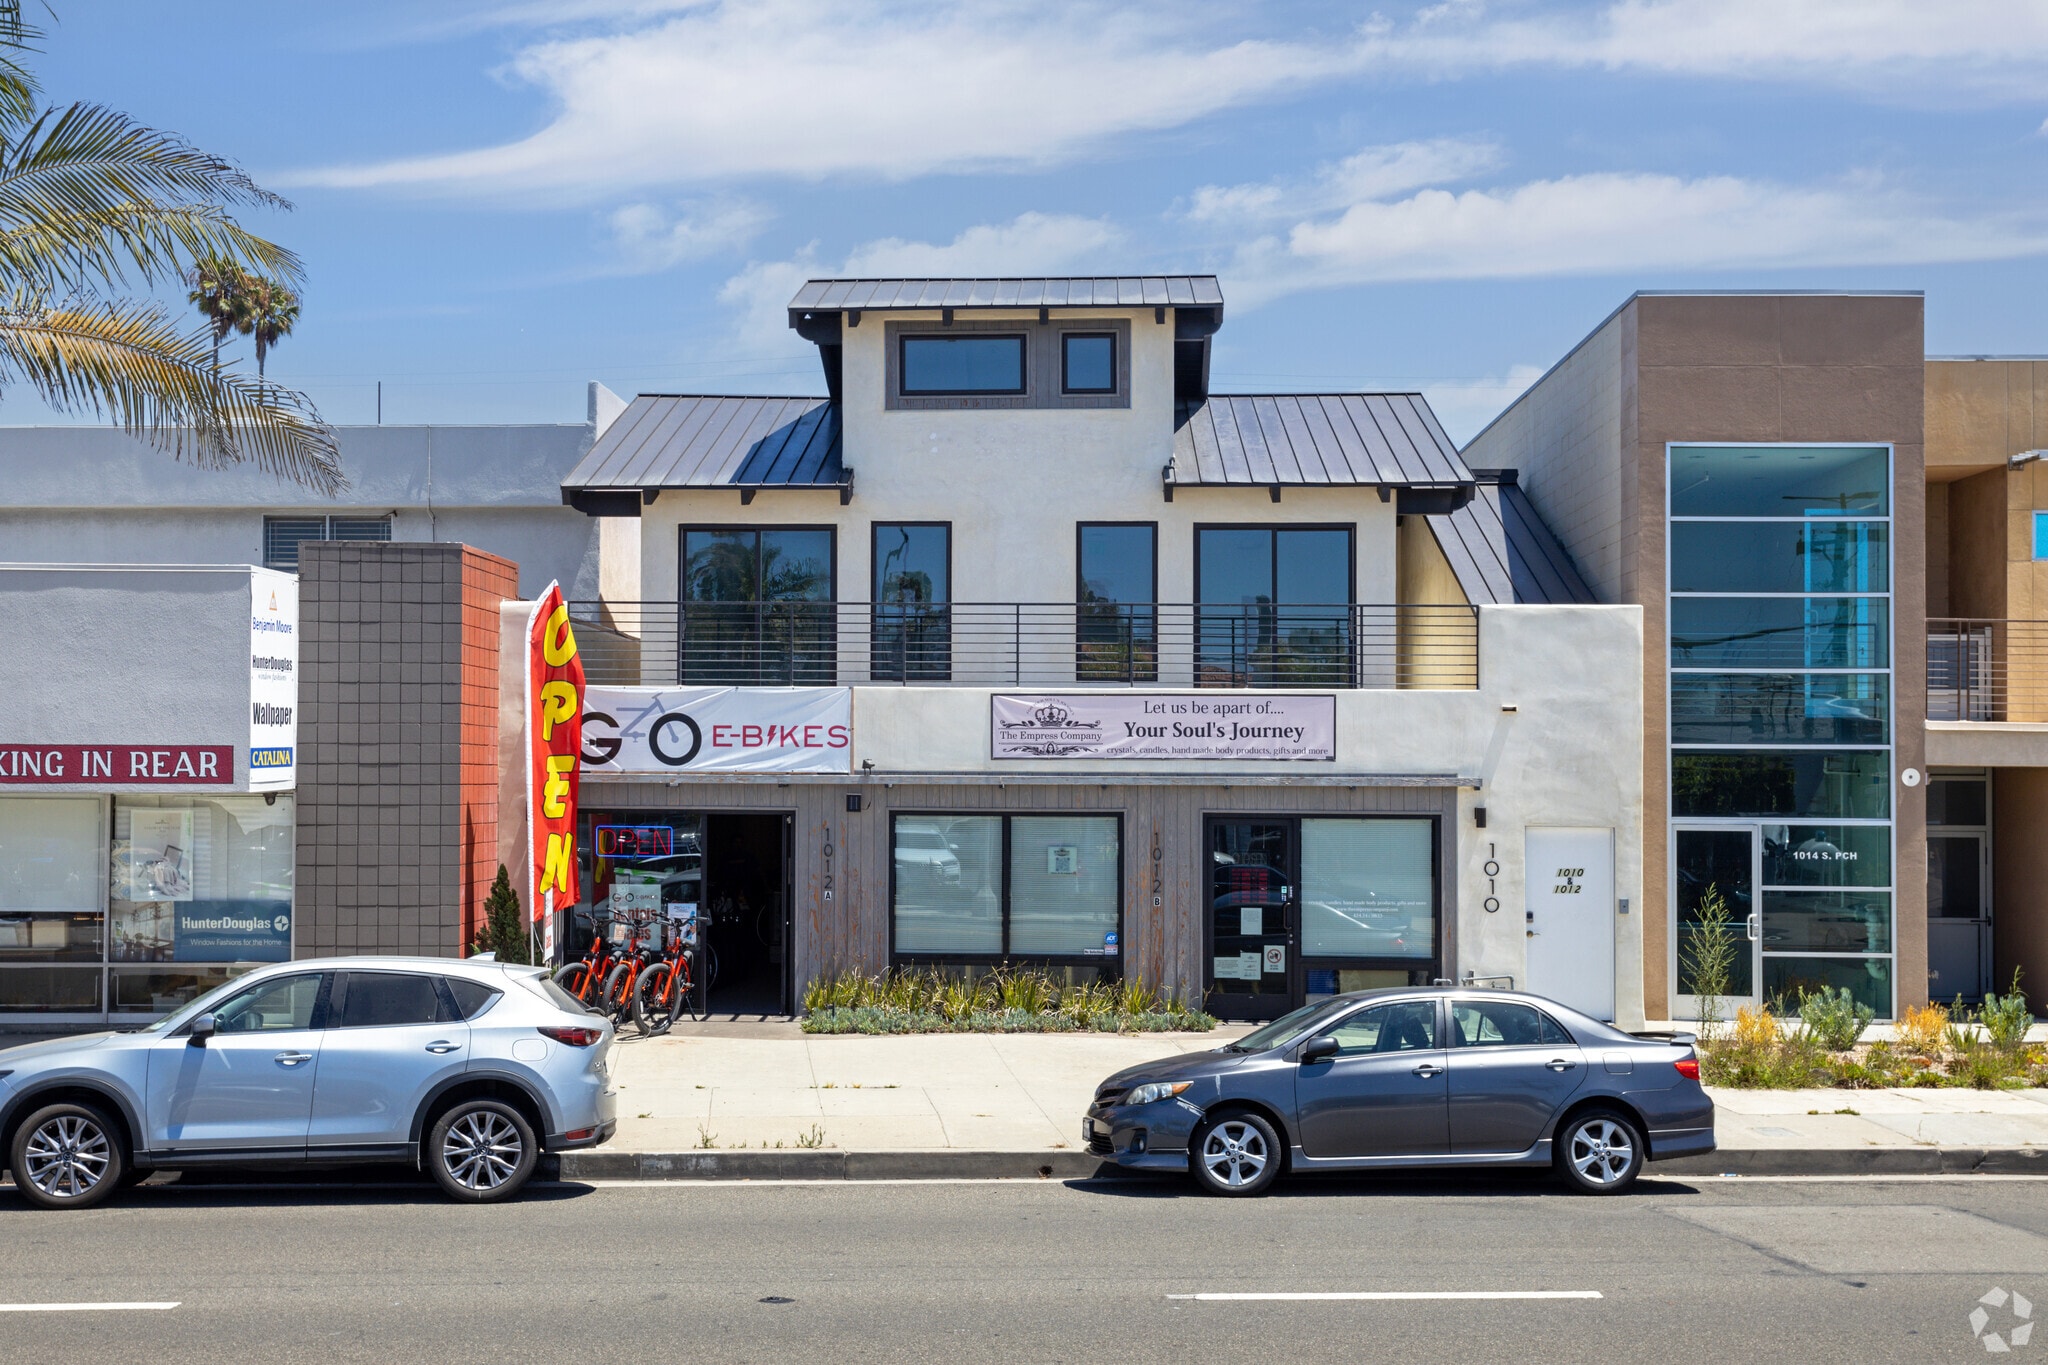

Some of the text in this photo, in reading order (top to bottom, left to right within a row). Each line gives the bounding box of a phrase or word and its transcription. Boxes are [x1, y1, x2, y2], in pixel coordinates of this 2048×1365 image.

[253, 617, 292, 634] Benjamin Moore
[252, 654, 293, 672] HunterDouglas
[252, 702, 292, 727] Wallpaper
[1144, 701, 1166, 714] Let
[1171, 704, 1187, 714] us
[1192, 701, 1209, 714] be
[1213, 702, 1250, 717] apart
[1000, 731, 1102, 741] The Empress Company
[1124, 722, 1305, 743] Your Soul's Journey
[540, 604, 578, 894] OPEN
[1106, 747, 1137, 755] crystals,
[1139, 747, 1169, 755] candles,
[1215, 747, 1234, 756] body
[1236, 747, 1271, 756] products,
[1273, 747, 1290, 756] gifts
[81, 751, 113, 777] IN
[129, 751, 219, 777] REAR
[252, 750, 291, 766] CATALINA
[599, 829, 671, 855] OPEN
[823, 828, 833, 900] 1012 A
[1793, 851, 1858, 860] 1014 S. PCH
[1153, 832, 1162, 906] 1012 B
[1557, 868, 1585, 877] 1010
[1484, 843, 1500, 913] 1010
[1567, 877, 1573, 885] &
[1554, 885, 1582, 894] 1012
[182, 916, 271, 931] HunterDouglas
